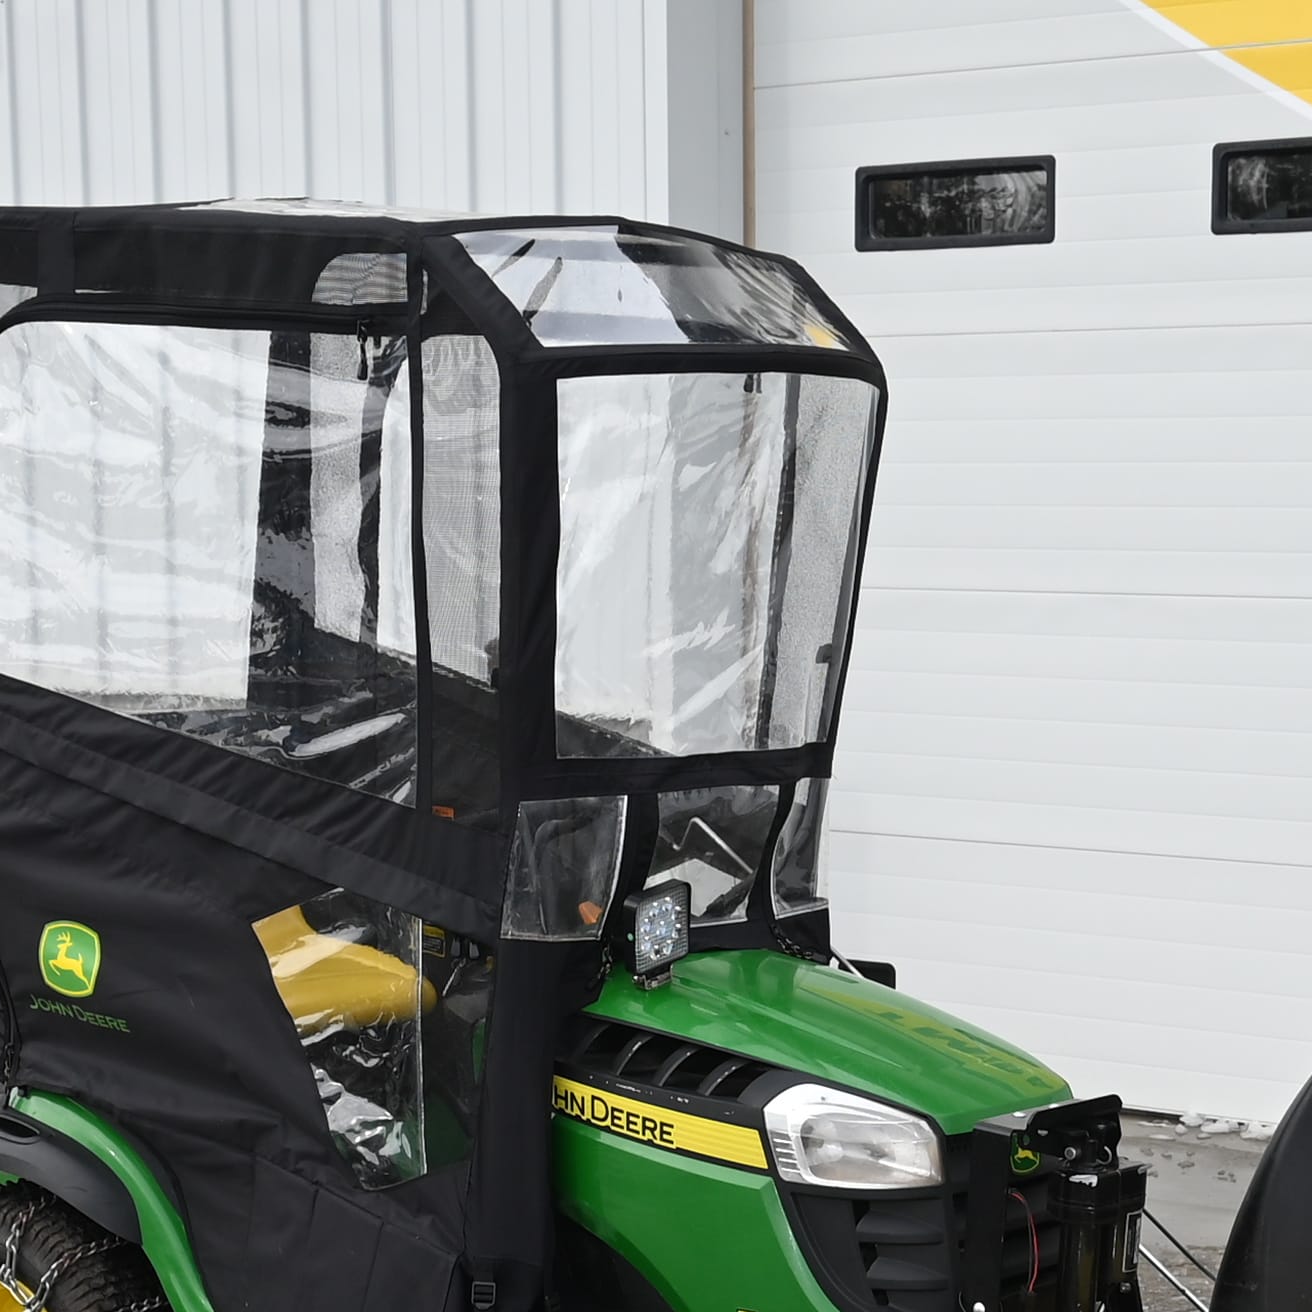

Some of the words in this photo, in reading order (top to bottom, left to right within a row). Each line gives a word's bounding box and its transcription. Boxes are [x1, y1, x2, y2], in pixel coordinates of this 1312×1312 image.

[29, 993, 74, 1018] JOHN
[72, 1004, 130, 1033] DEERE
[553, 1084, 586, 1117] HN
[591, 1094, 675, 1146] DEERE
